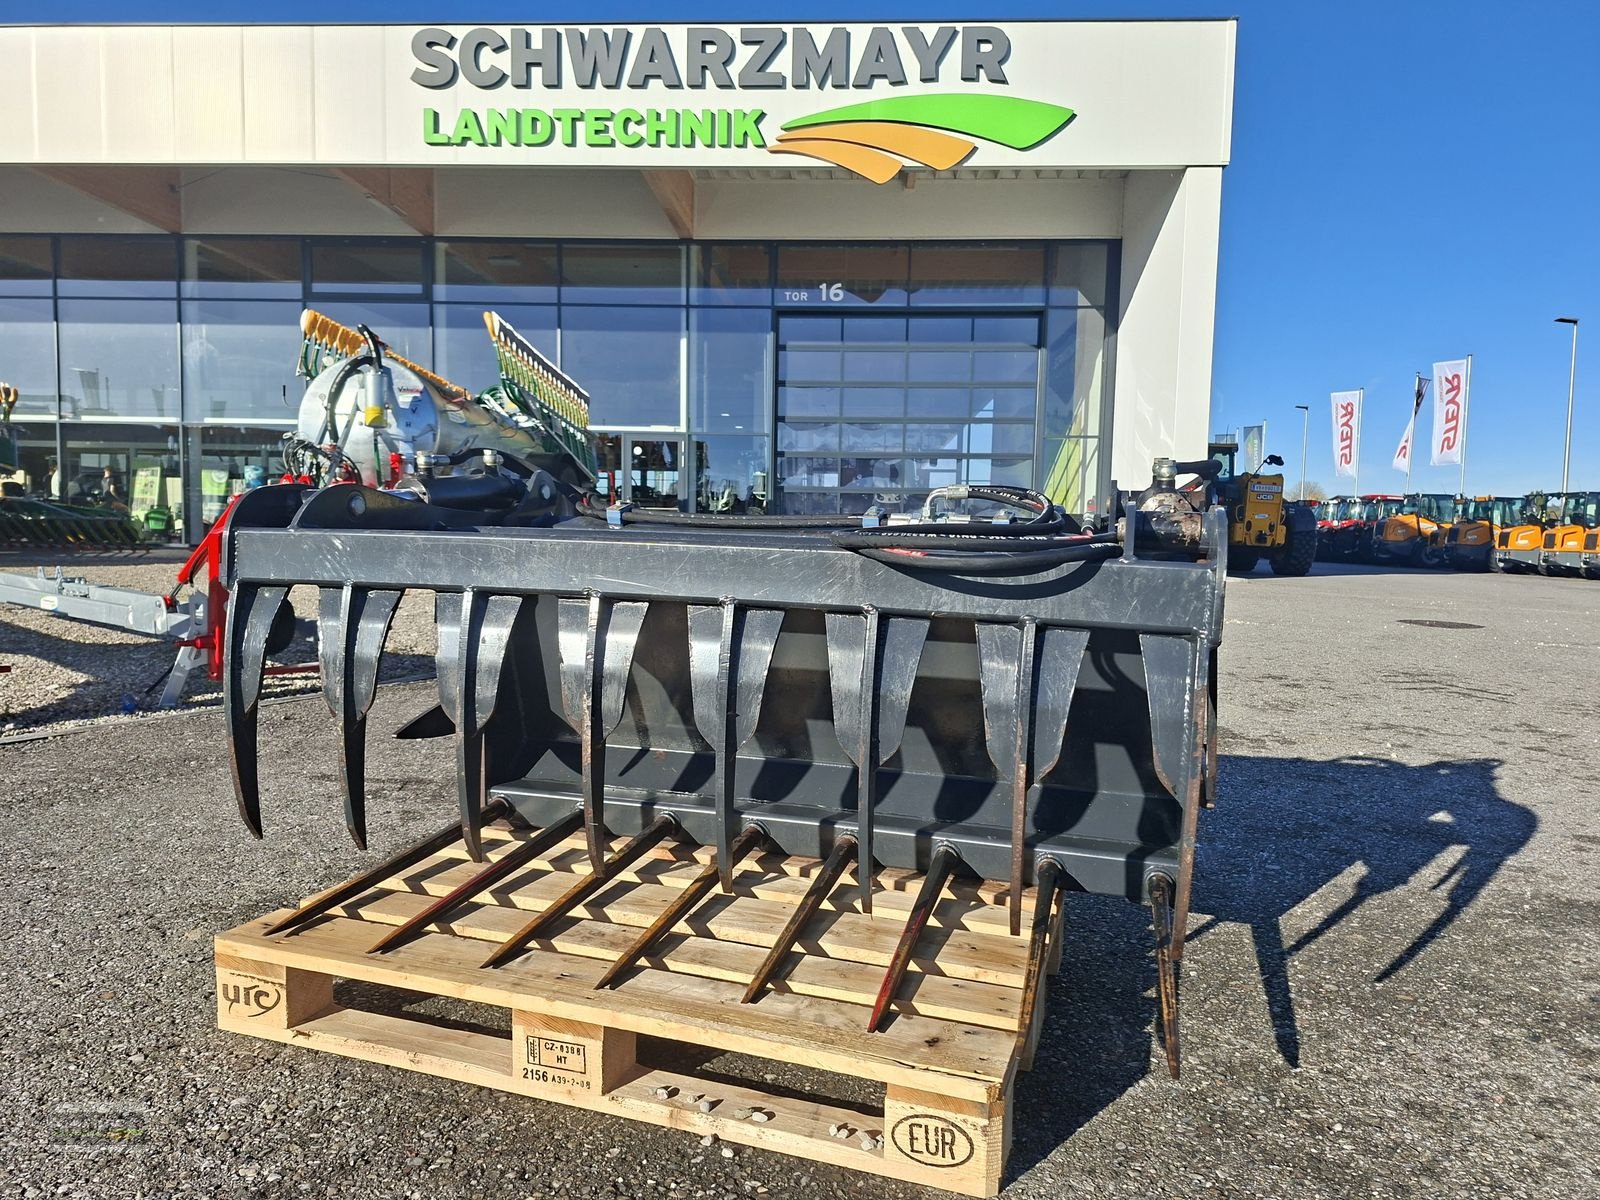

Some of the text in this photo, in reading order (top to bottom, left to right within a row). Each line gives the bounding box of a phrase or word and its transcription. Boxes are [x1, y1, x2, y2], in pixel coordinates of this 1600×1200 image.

[410, 25, 1011, 90] SCHWARZMAYR
[423, 107, 767, 149] LANDTECHNIK
[784, 282, 844, 301] TOR 16
[556, 1055, 568, 1064] HT
[522, 1067, 548, 1083] 2156
[908, 1122, 956, 1161] EUR
